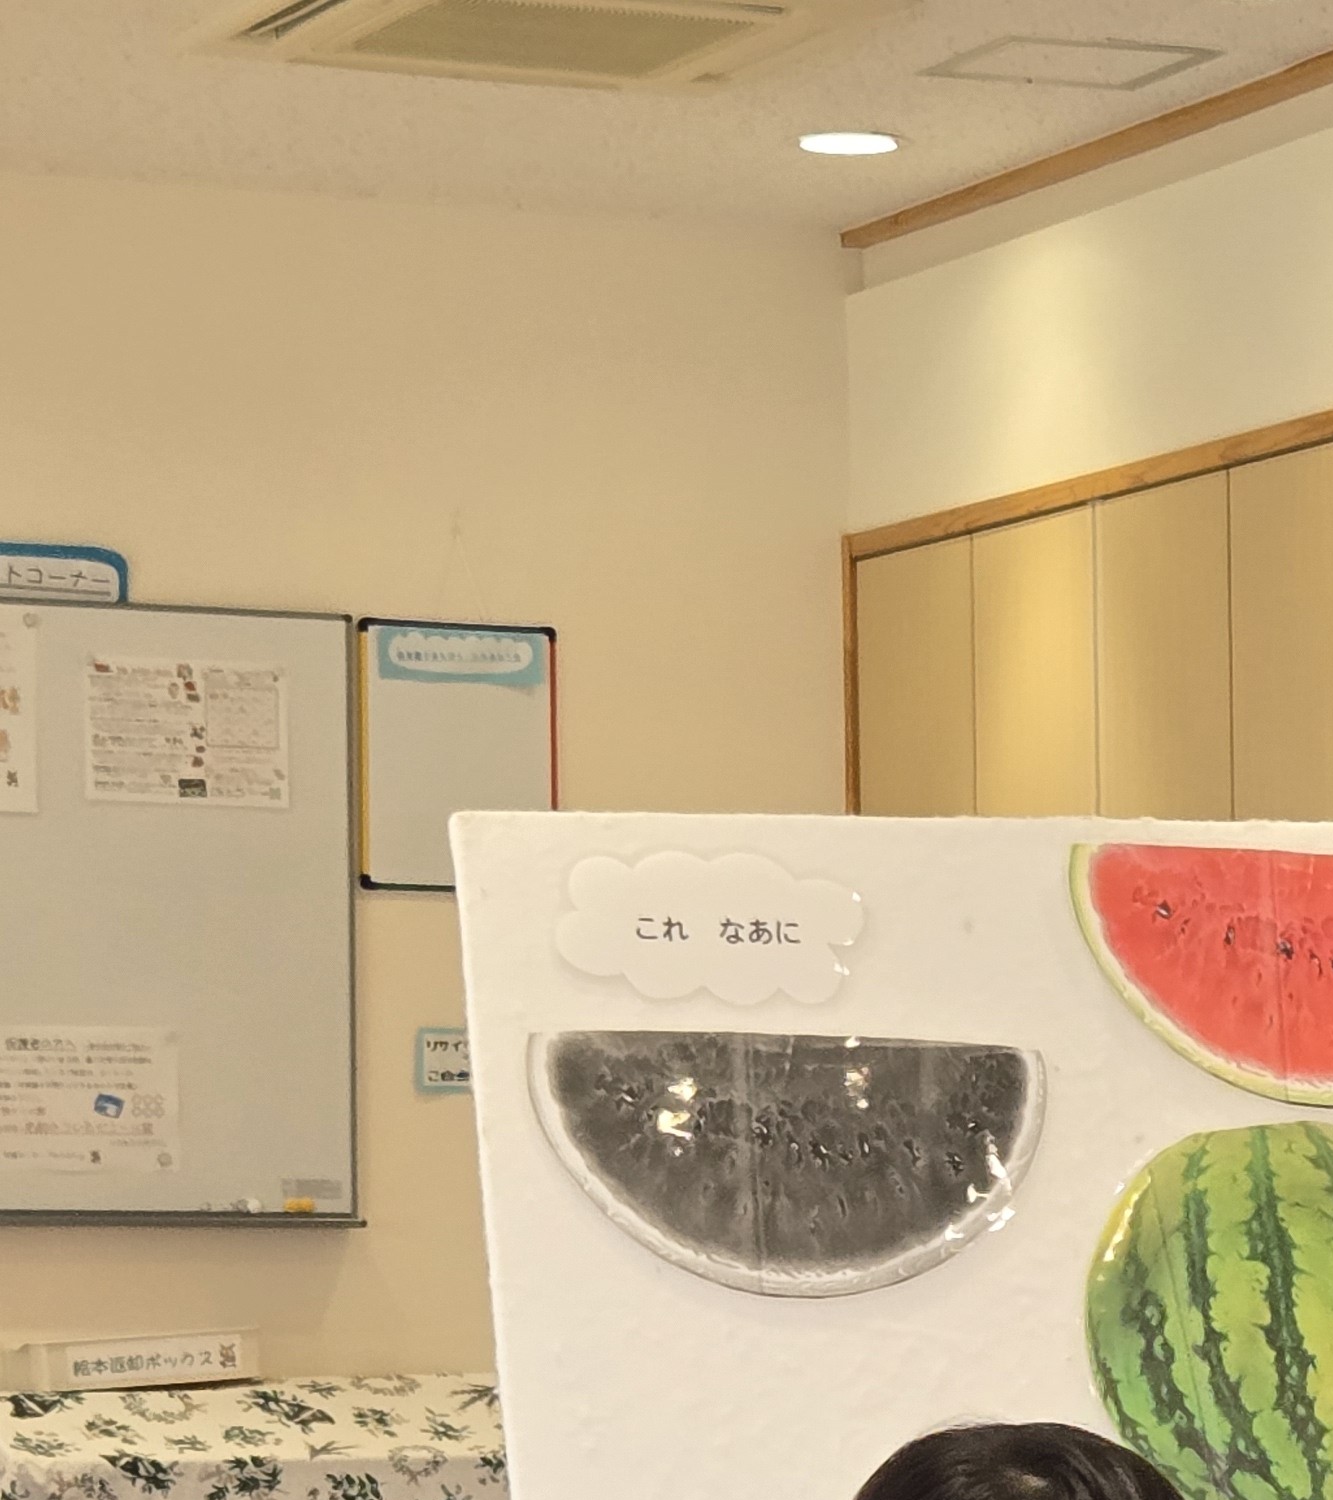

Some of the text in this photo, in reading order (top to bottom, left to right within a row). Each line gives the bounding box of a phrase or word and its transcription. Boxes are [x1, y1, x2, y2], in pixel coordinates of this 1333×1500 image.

[635, 916, 801, 945] これ なあに
[426, 1040, 469, 1052] リサイ
[73, 1350, 213, 1377] 絵本返却ボックス
